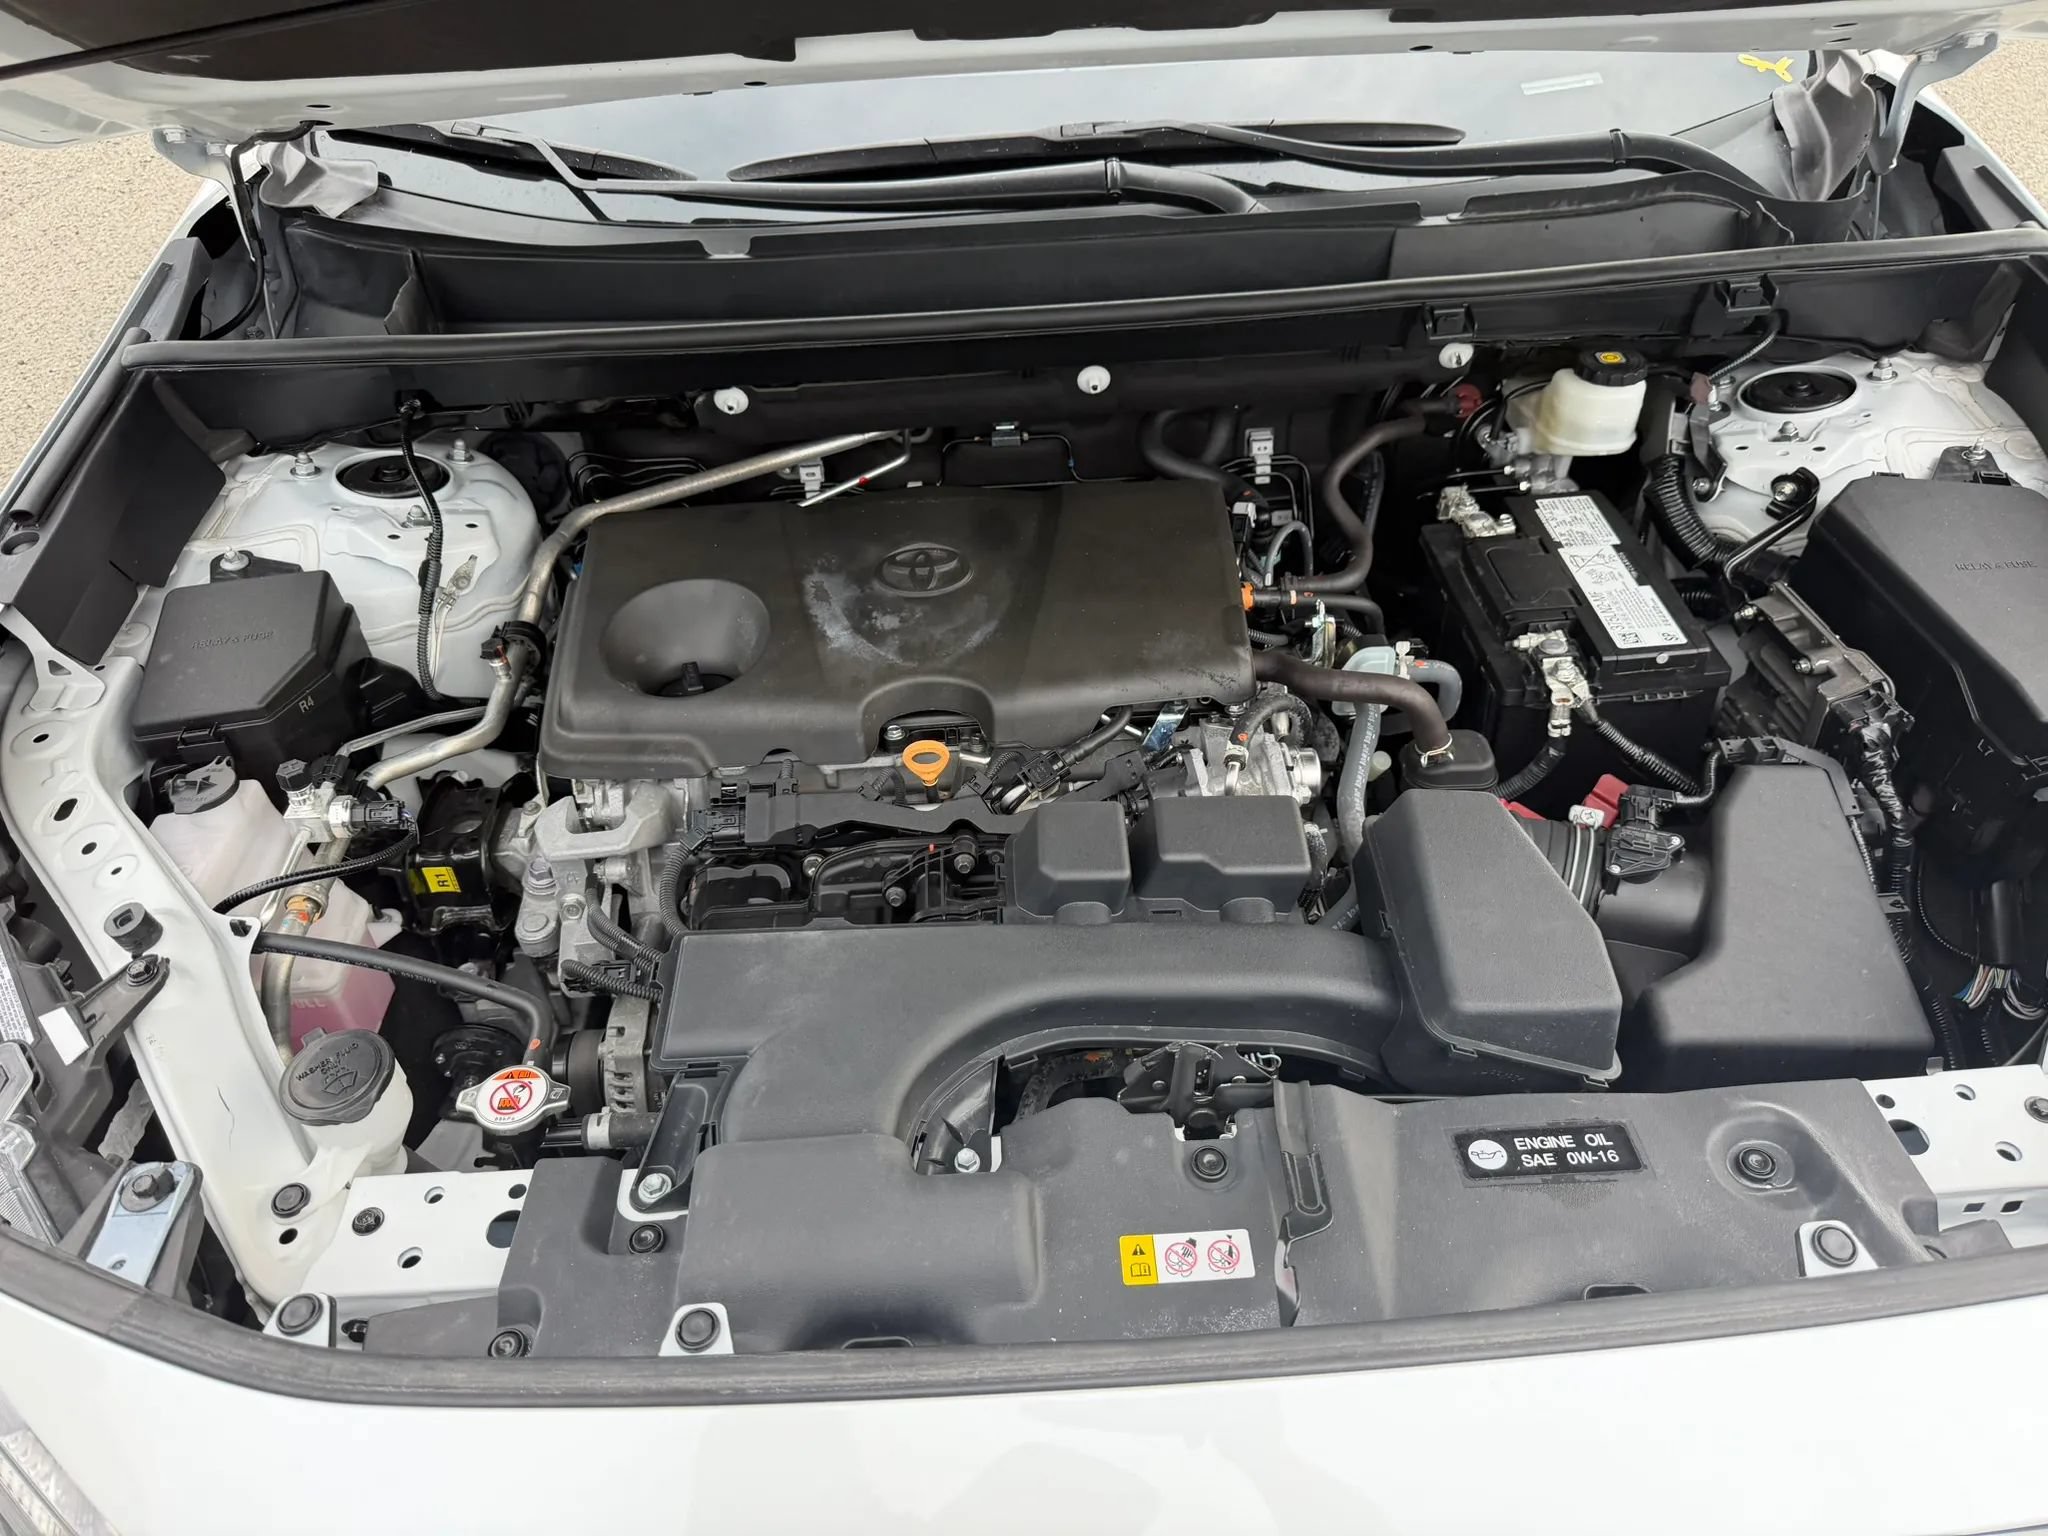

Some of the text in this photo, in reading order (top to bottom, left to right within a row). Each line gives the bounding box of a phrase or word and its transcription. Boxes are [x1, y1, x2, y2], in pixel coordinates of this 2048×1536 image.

[298, 695, 315, 713] R4
[434, 873, 451, 888] R1
[295, 1057, 333, 1082] WASHER
[1513, 1132, 1614, 1151] ENGINE OIL
[1520, 1149, 1621, 1168] SAE 0W-16
